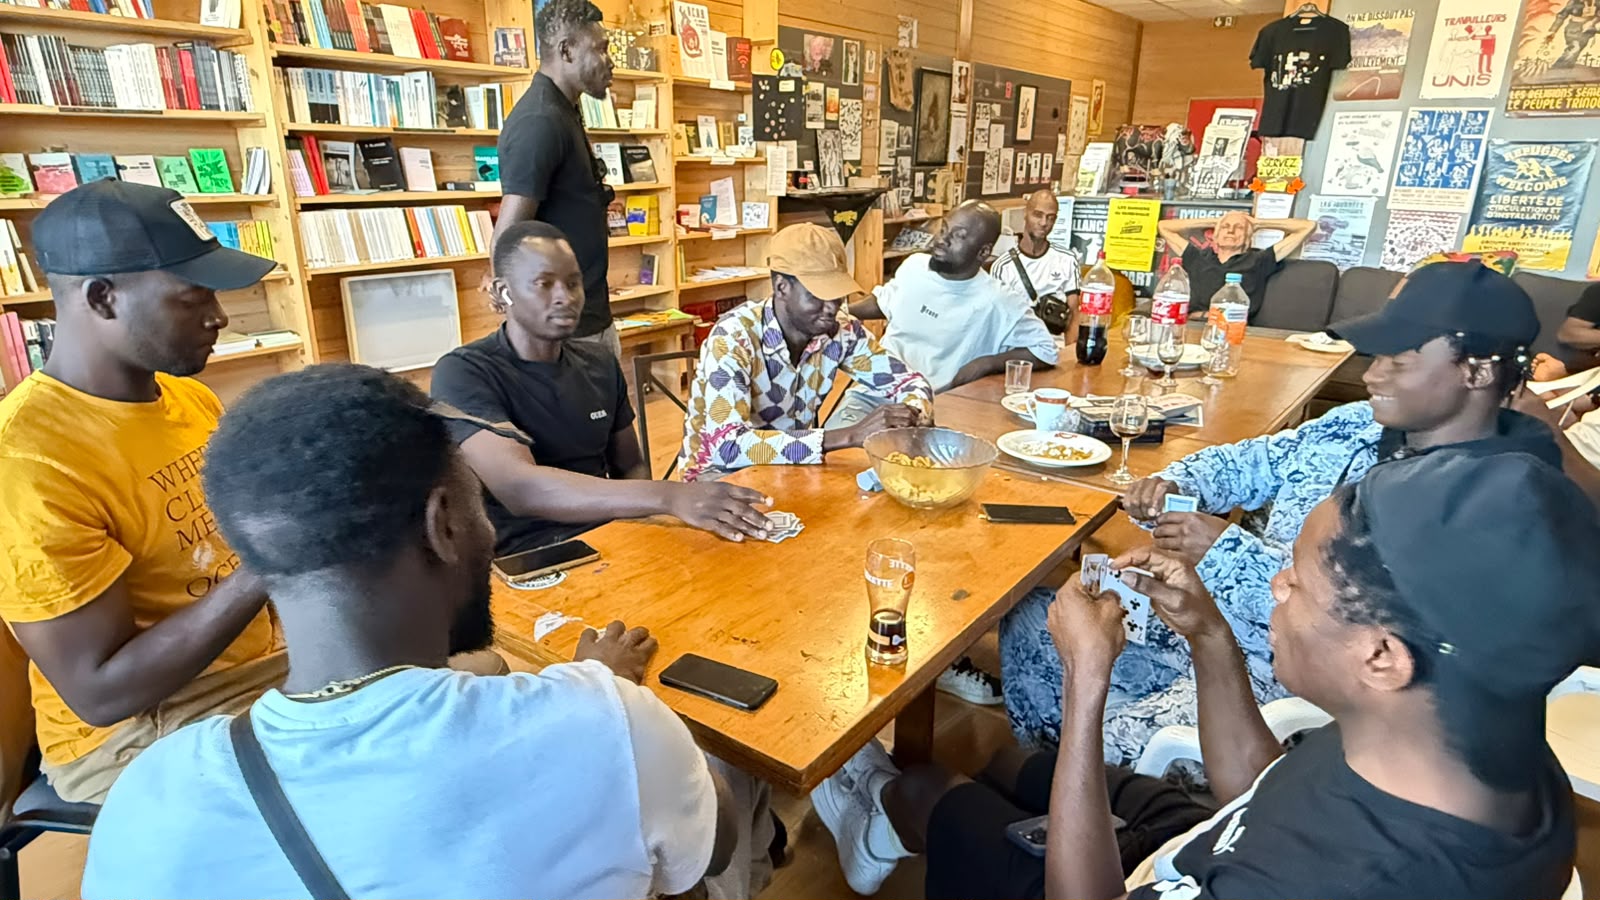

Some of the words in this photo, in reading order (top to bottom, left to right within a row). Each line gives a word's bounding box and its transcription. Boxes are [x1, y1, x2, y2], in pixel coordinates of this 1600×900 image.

[1444, 13, 1507, 27] TRAVAILLEURS
[1432, 72, 1493, 88] UNIS
[1509, 90, 1526, 100] LES
[1527, 88, 1574, 99] RELIGIONS
[1507, 100, 1521, 110] LE
[1522, 98, 1563, 110] PEUPLE
[1503, 144, 1576, 163] REFUGEES
[1261, 157, 1297, 168] SERVEZ
[1495, 175, 1568, 192] WELCOME
[1546, 196, 1564, 207] DE
[1487, 204, 1549, 214] CIRCULATION
[1550, 206, 1562, 214] ET
[1486, 211, 1560, 221] D'INSTALLATION
[1120, 270, 1154, 287] ART
